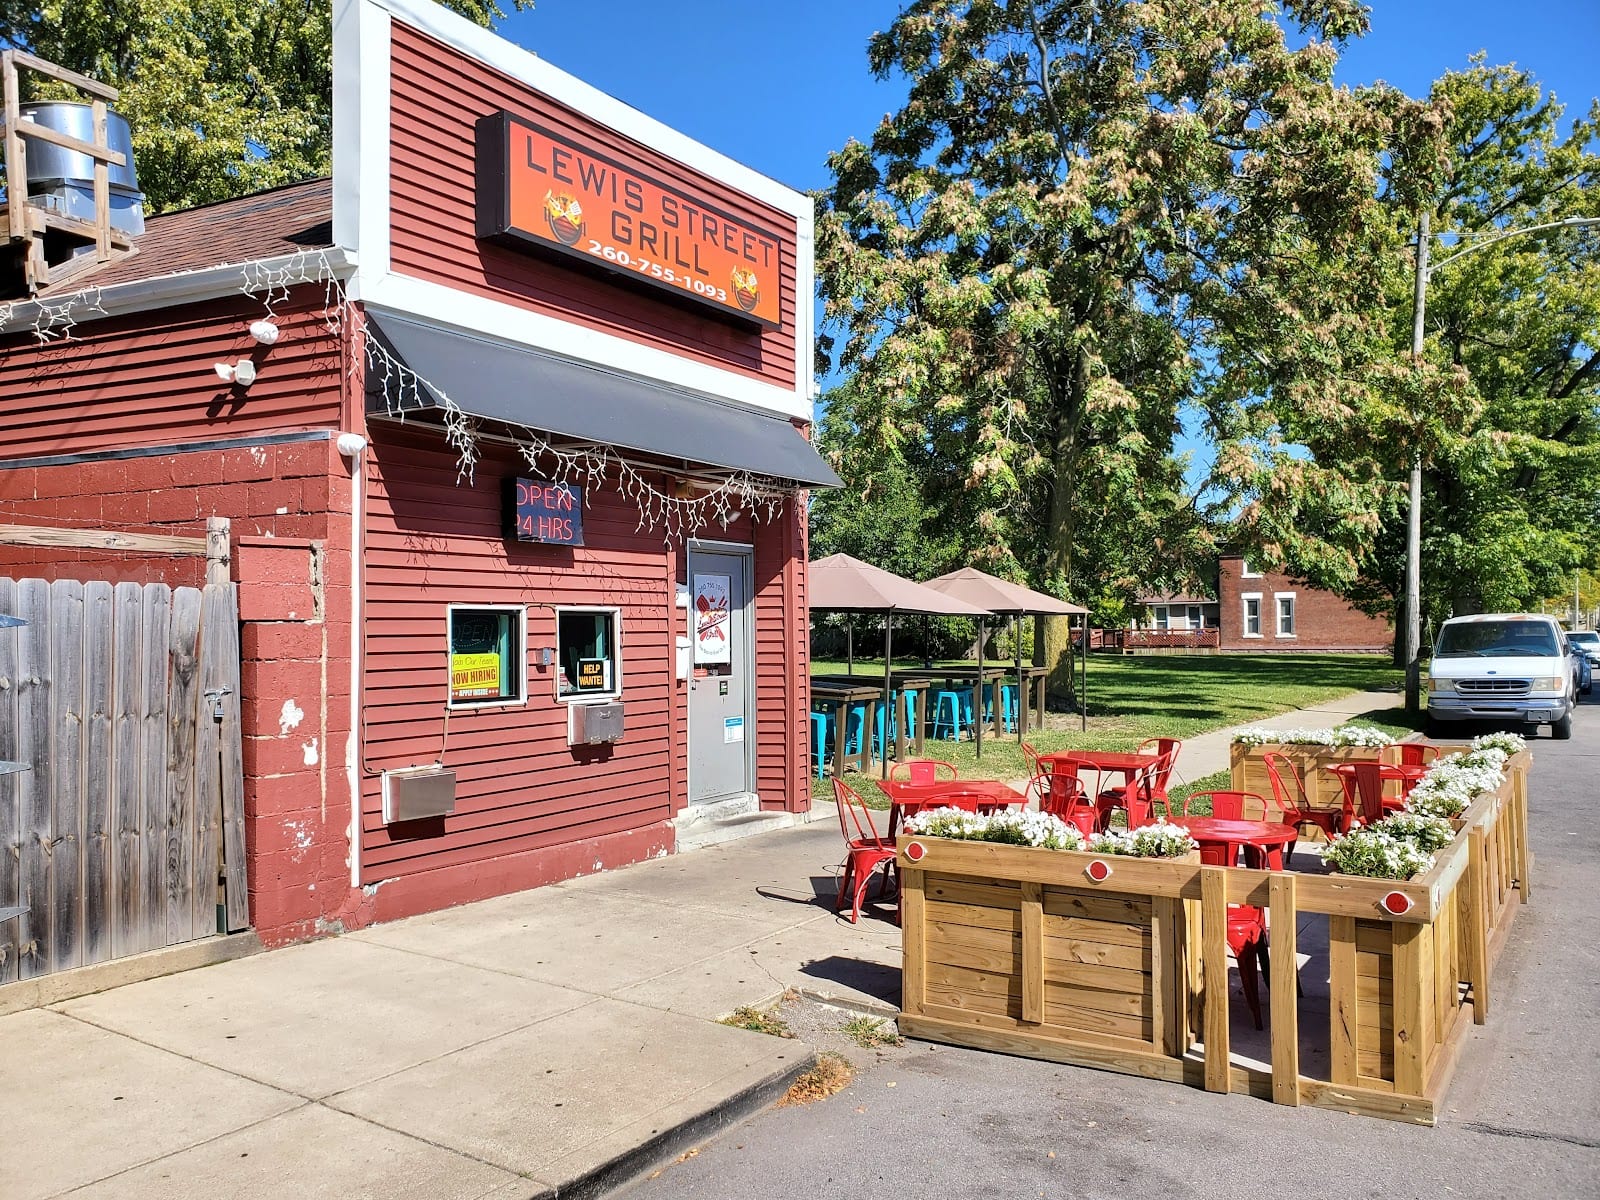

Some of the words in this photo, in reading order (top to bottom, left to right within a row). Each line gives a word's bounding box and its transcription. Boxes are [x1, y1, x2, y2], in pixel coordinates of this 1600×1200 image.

[527, 135, 643, 213] LEWIS
[662, 196, 774, 268] STREET
[611, 210, 709, 276] GRILL
[588, 240, 727, 301] 260-755-1093
[516, 483, 572, 511] OPEN
[538, 516, 573, 540] HRS
[452, 672, 469, 685] NOW
[470, 668, 496, 683] HIRING
[583, 663, 601, 674] HELP
